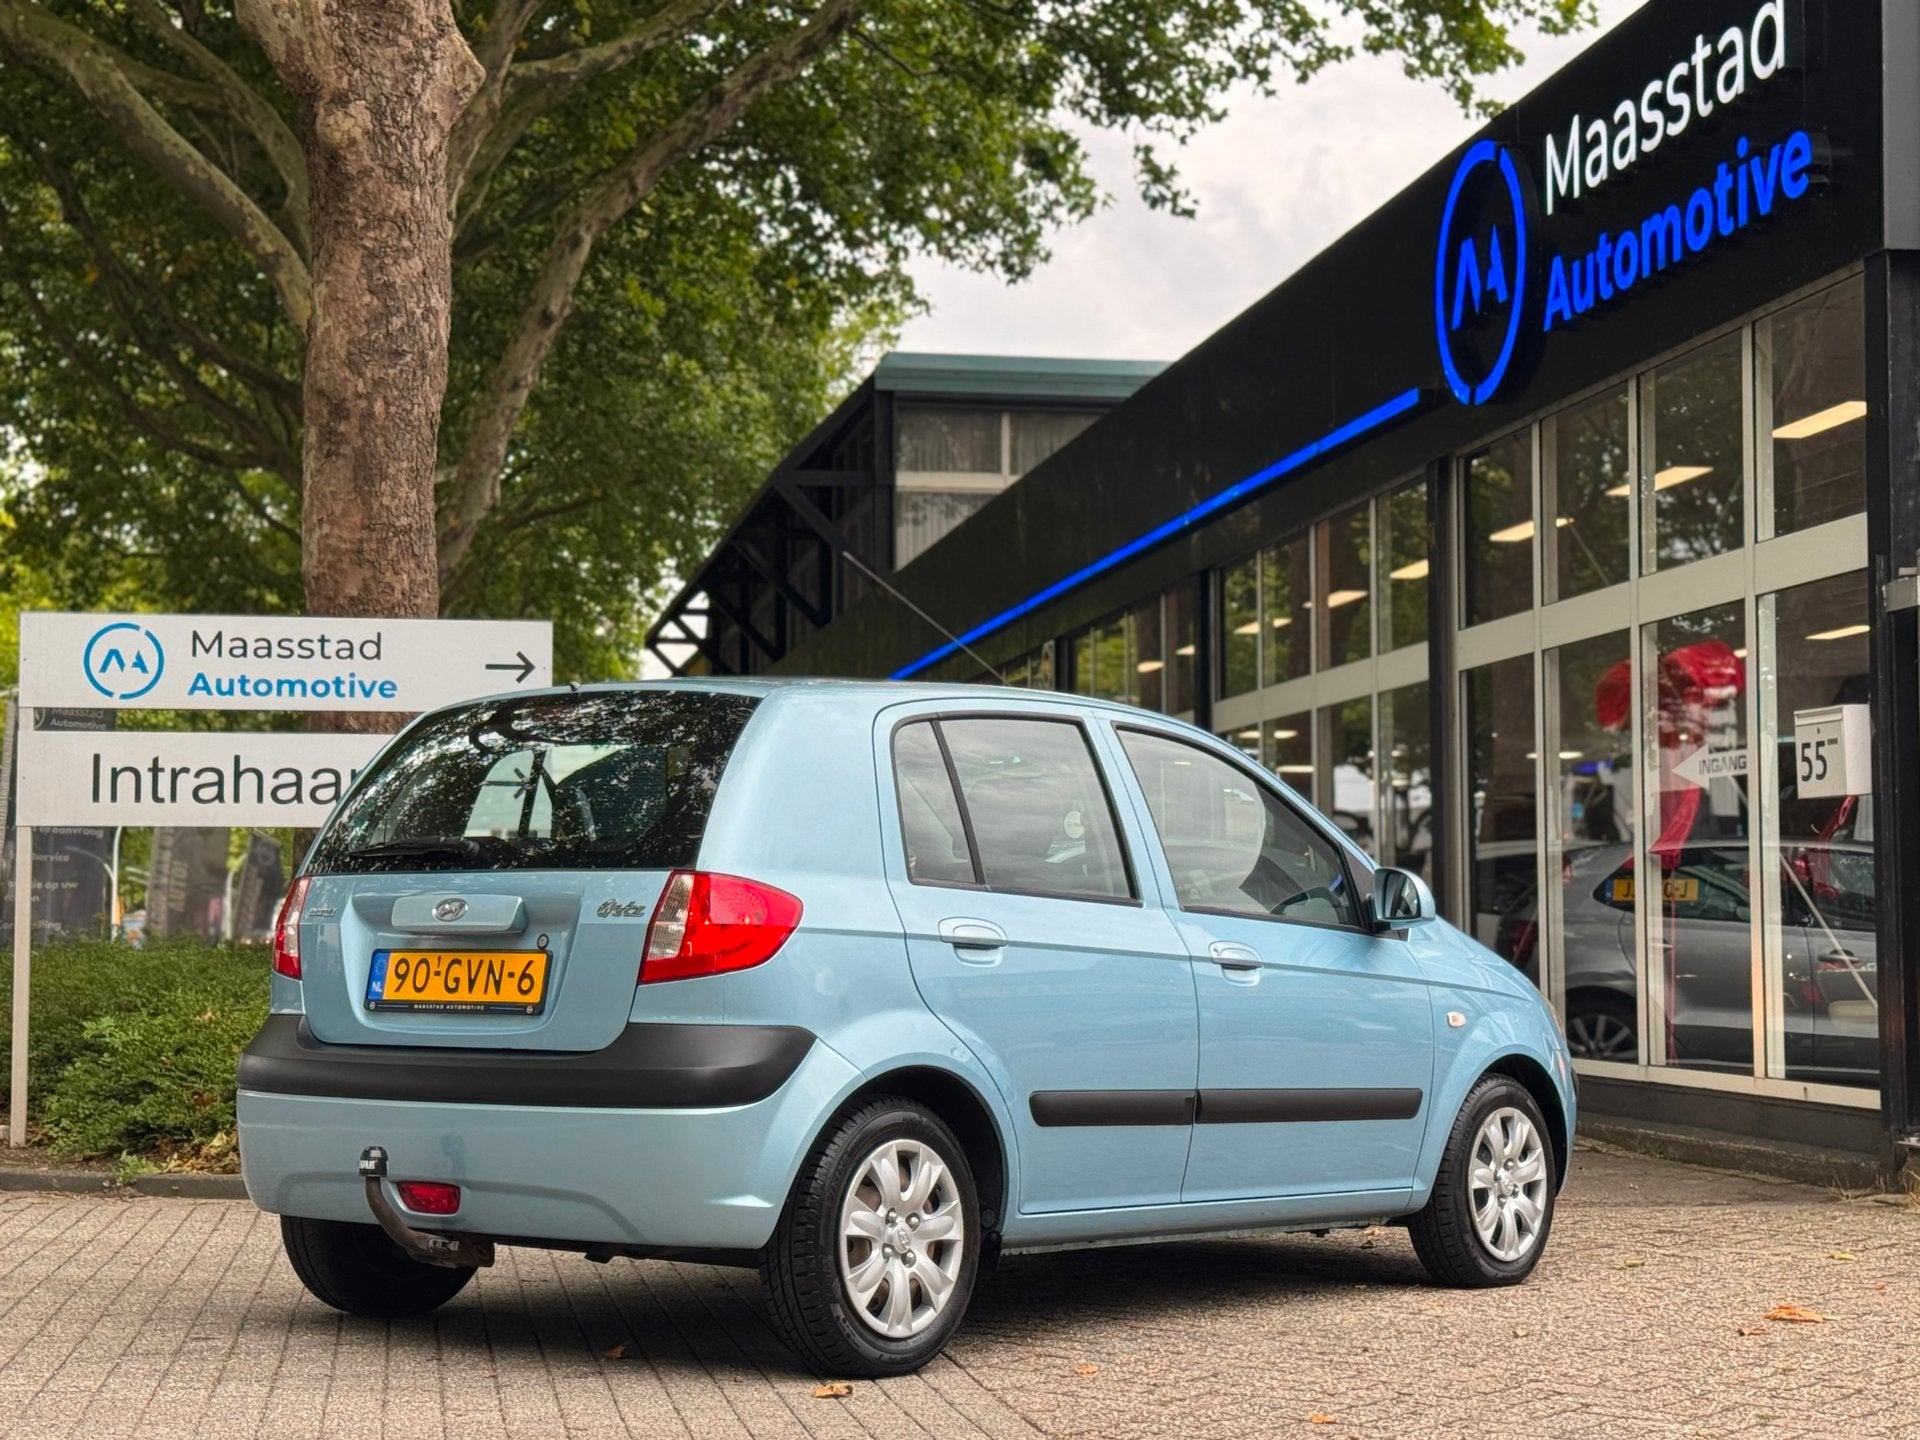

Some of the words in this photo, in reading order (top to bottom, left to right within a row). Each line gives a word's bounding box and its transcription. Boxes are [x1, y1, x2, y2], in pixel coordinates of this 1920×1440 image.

[1546, 0, 1785, 216] Maasstad
[1544, 131, 1813, 332] Automotive
[191, 630, 383, 661] Maasstad
[187, 672, 398, 698] Automotive
[50, 718, 107, 730] Automotive
[1801, 741, 1828, 782] 55
[371, 981, 383, 993] NL
[394, 957, 535, 996] 90-GVN-6
